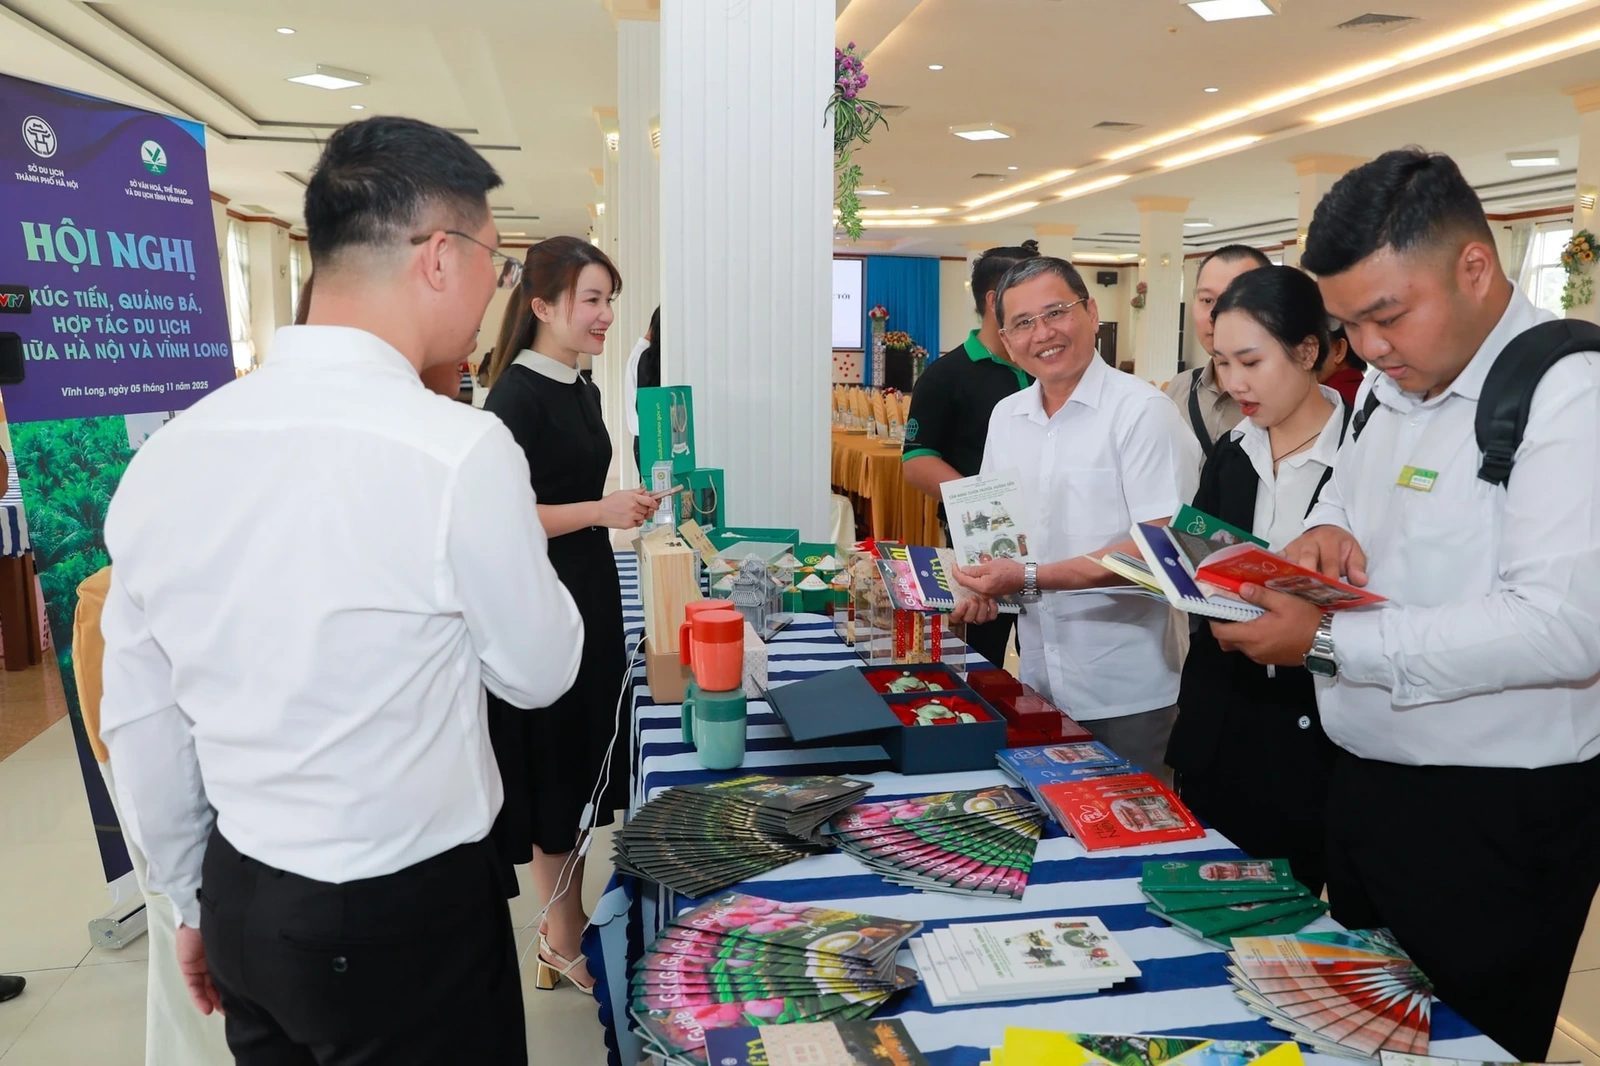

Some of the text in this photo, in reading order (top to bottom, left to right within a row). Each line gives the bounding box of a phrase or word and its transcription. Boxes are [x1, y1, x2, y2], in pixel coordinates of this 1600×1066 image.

[15, 172, 79, 190] THÀNH PHỐ HÀ NỘI
[28, 163, 64, 177] SỞ DU LỊCH
[125, 188, 134, 196] VÀ
[143, 191, 154, 199] LỊCH
[180, 197, 194, 205] LONG
[20, 217, 196, 281] HỘI NGHỊ
[0, 293, 24, 308] VTV
[30, 284, 202, 314] XÚC TIẾN, QUẢNG BÁ,
[52, 313, 191, 338] HỢP TÁC DU LỊCH
[22, 338, 229, 363] IỮA HÀ NỘI VÀ VĨNH LONG
[61, 380, 209, 398] Vĩnh Long, ngày 05 tháng 11 năm 2025
[899, 577, 916, 606] Guide
[691, 907, 735, 927] Guide
[673, 1010, 706, 1042] Guide
